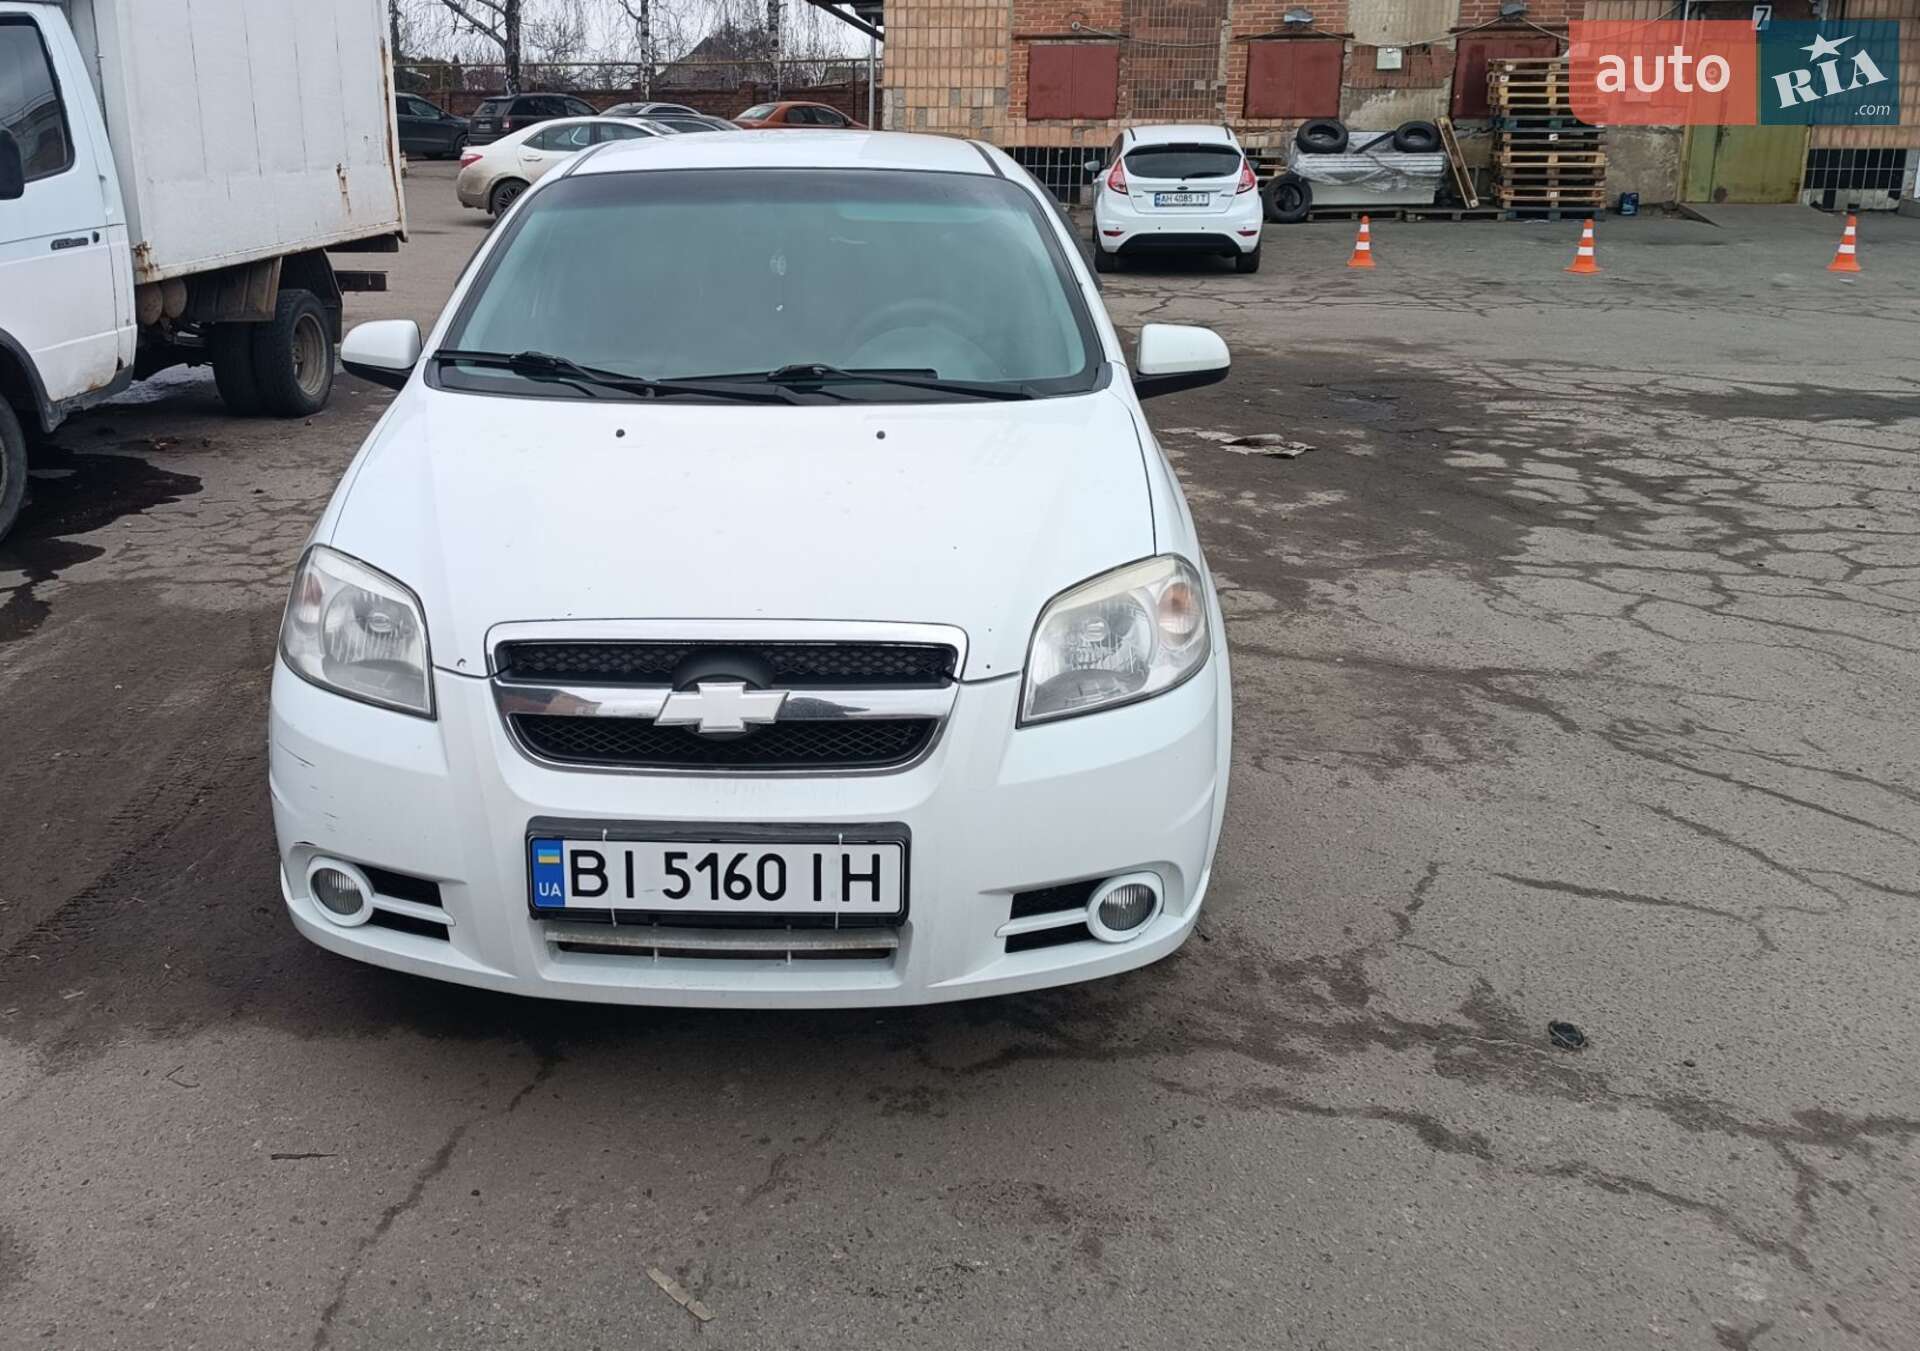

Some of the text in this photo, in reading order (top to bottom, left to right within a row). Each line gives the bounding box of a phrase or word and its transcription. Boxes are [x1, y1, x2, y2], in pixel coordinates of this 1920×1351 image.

[1756, 8, 1769, 28] 7
[570, 849, 881, 902] BI 5160 IH
[539, 882, 562, 897] UA
